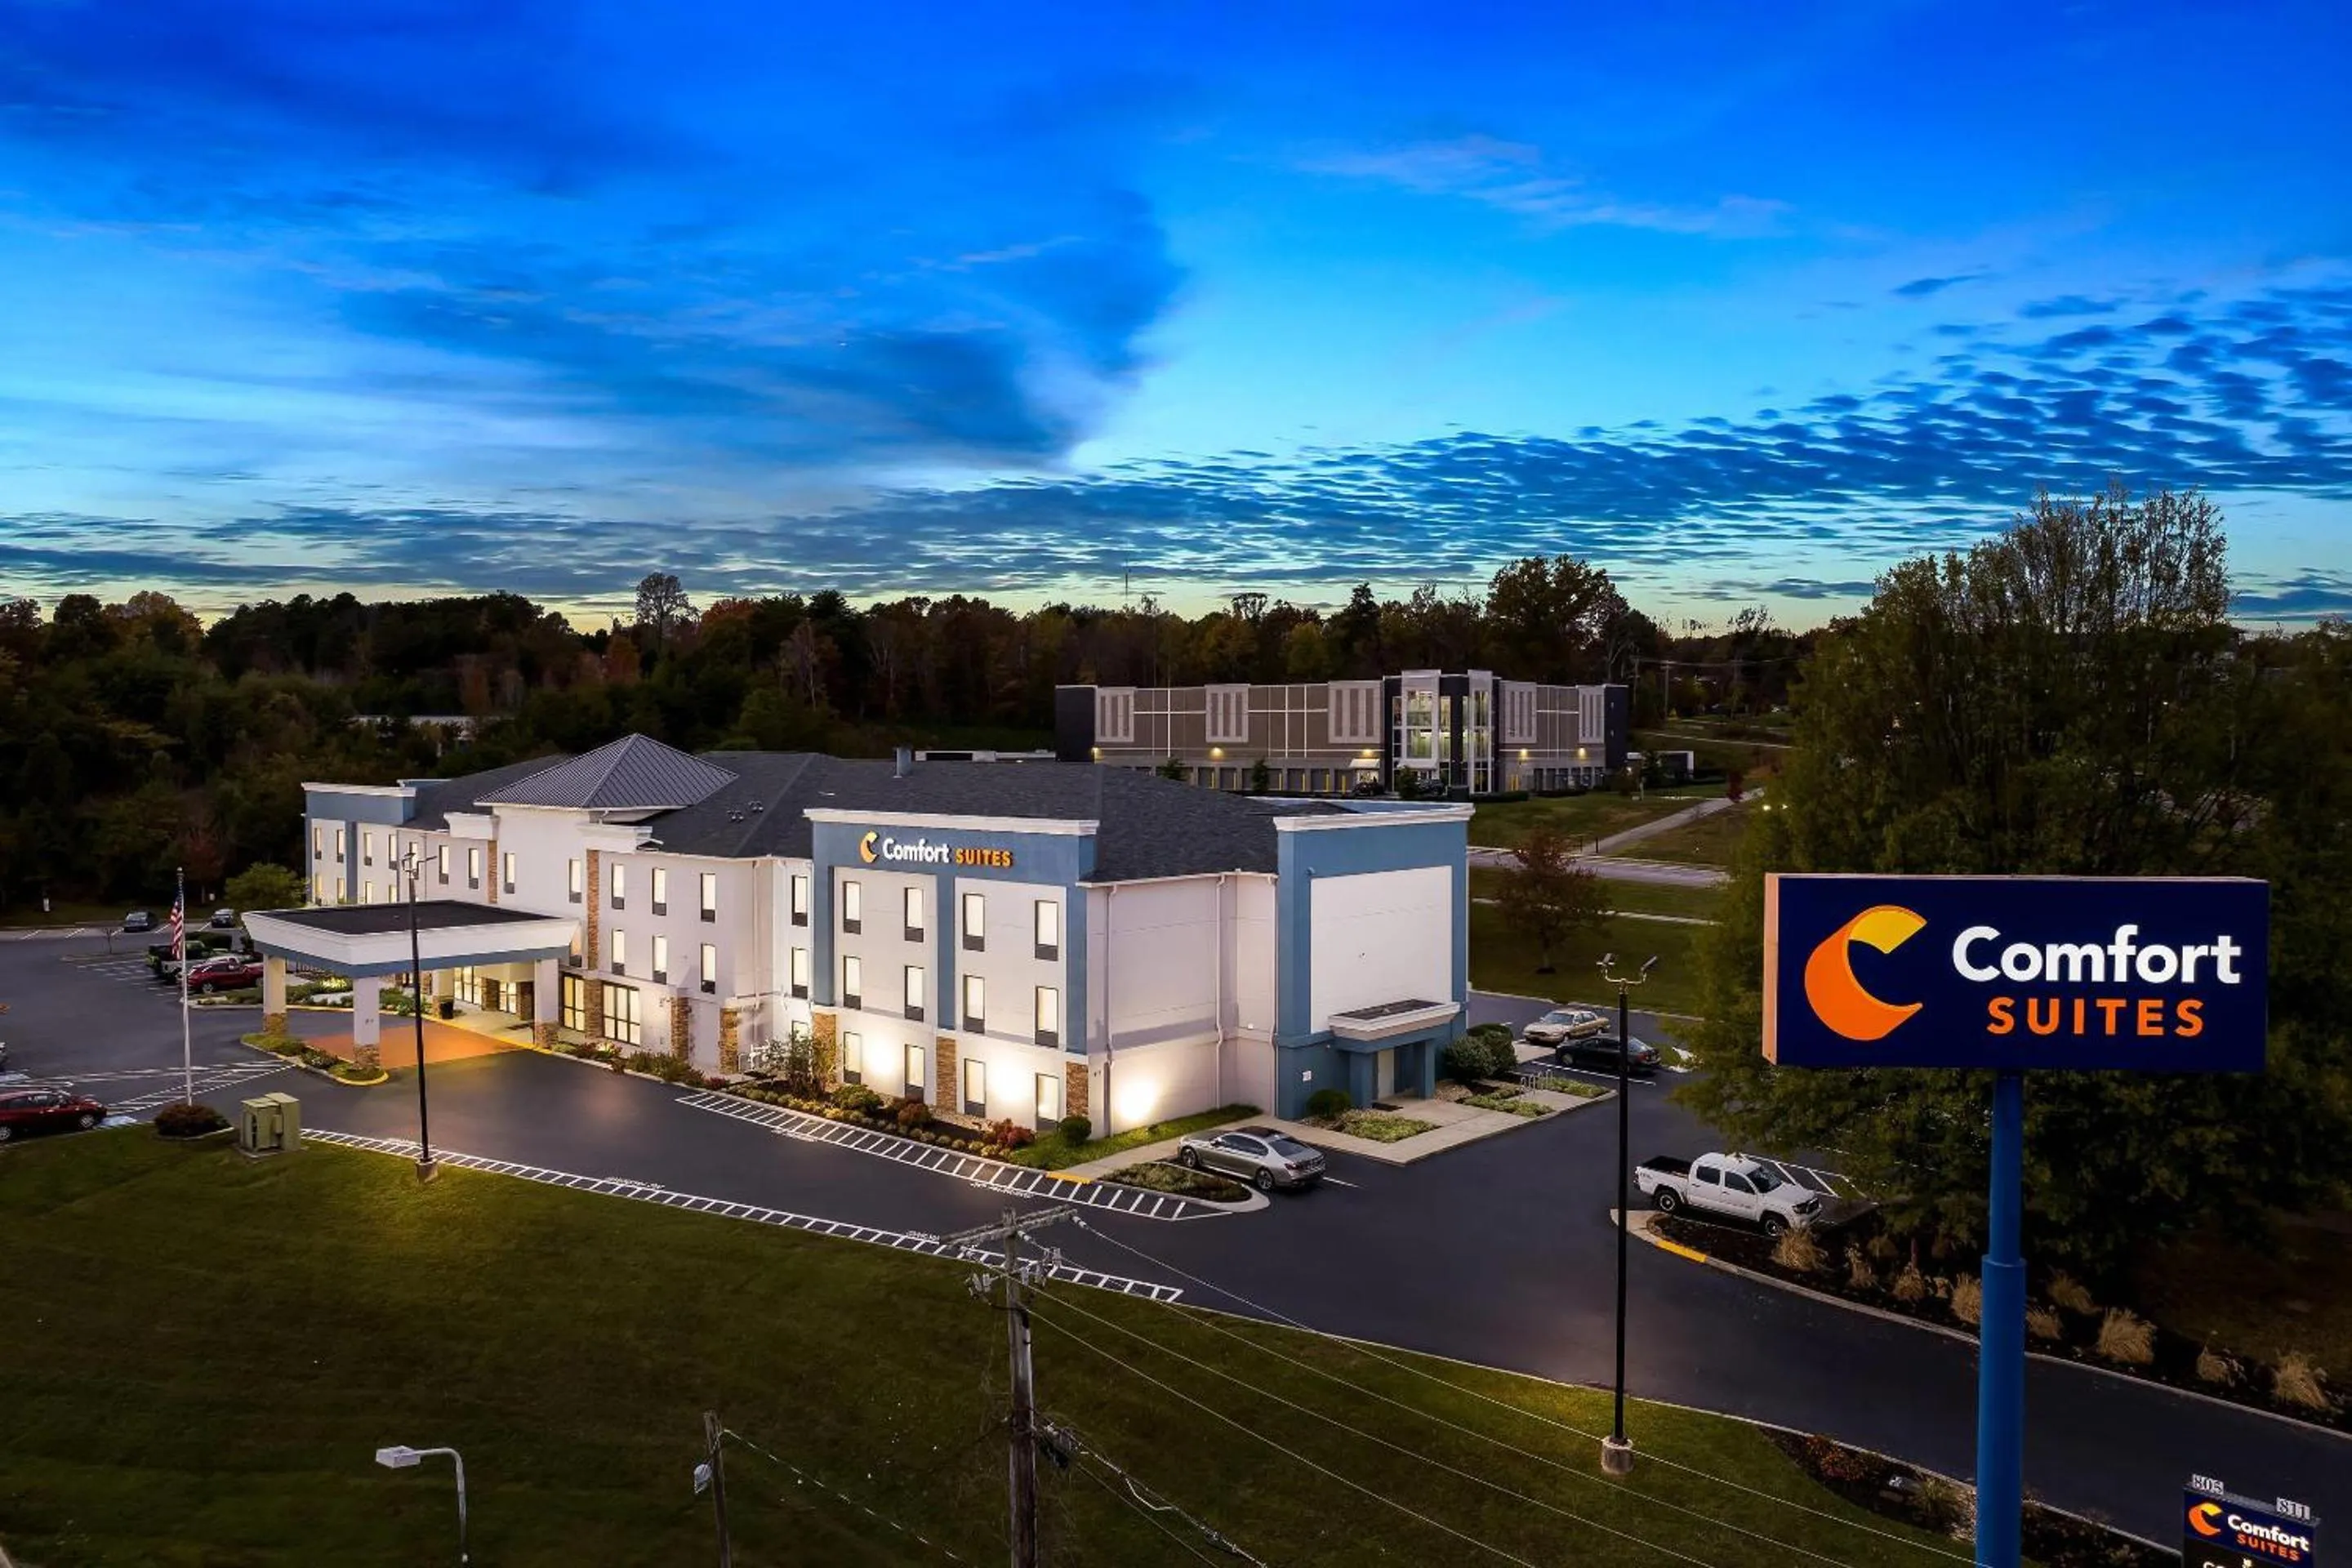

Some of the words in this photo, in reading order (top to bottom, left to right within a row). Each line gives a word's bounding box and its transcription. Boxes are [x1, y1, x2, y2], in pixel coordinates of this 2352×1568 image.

[882, 837, 950, 863] Comfort
[956, 848, 1011, 867] SUITES
[1952, 924, 2242, 985] Comfort
[1986, 996, 2205, 1037] SUITES
[2227, 1514, 2310, 1552] Comfort
[2236, 1534, 2301, 1561] SUITES
